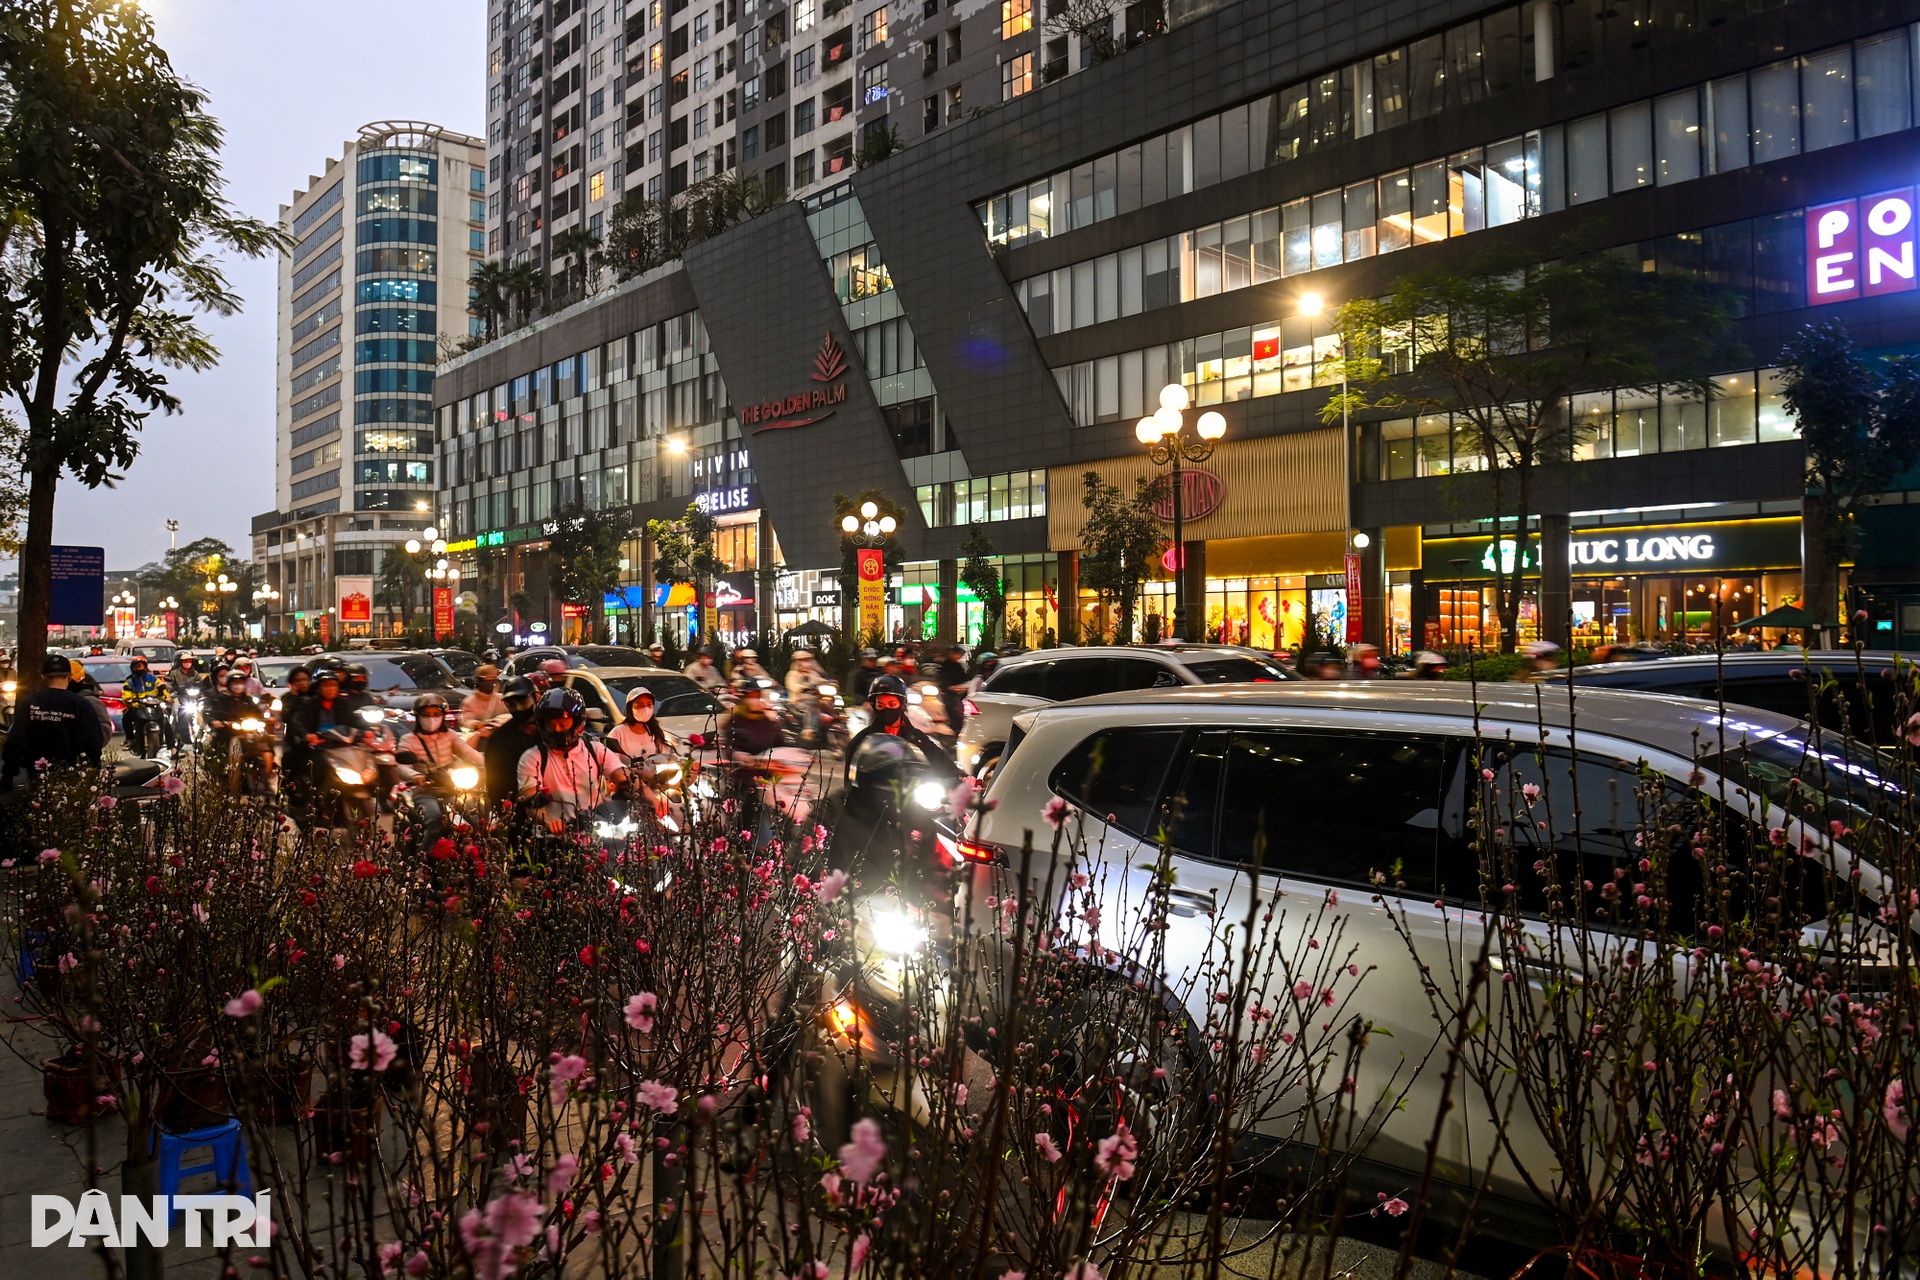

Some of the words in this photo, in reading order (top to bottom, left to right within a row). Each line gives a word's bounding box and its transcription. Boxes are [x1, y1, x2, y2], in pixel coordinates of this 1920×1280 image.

[741, 405, 760, 424] THE
[761, 391, 811, 420] GOLDEN
[812, 383, 845, 409] PALM
[711, 487, 749, 511] ELISE
[1537, 539, 1618, 565] UC
[1625, 535, 1715, 562] LONG
